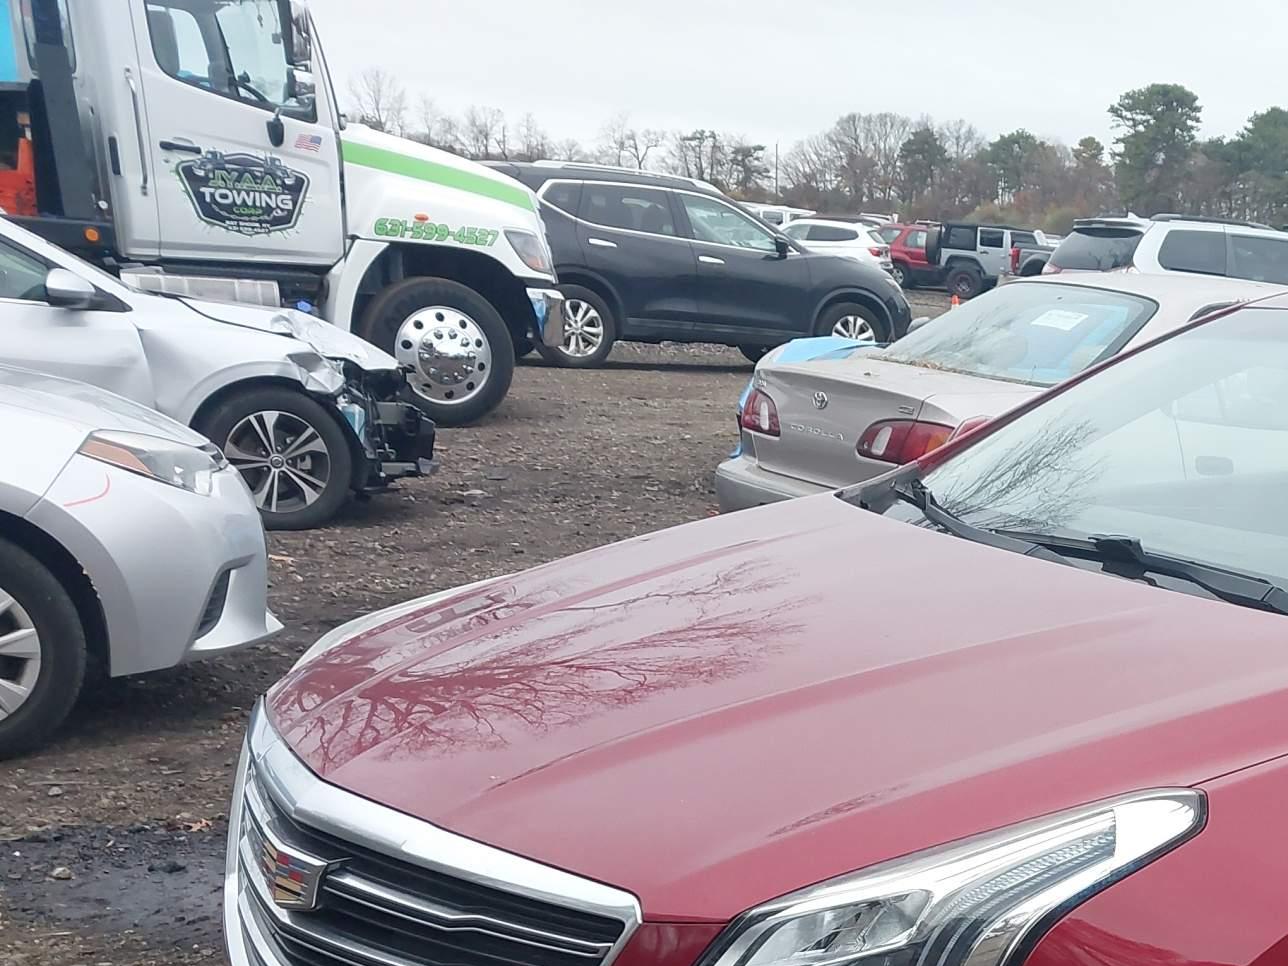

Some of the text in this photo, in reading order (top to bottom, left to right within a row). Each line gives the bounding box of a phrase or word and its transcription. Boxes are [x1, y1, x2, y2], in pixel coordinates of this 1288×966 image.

[200, 187, 293, 210] TOWING
[374, 217, 499, 247] 631-599-4527
[790, 423, 844, 441] COROLLA
